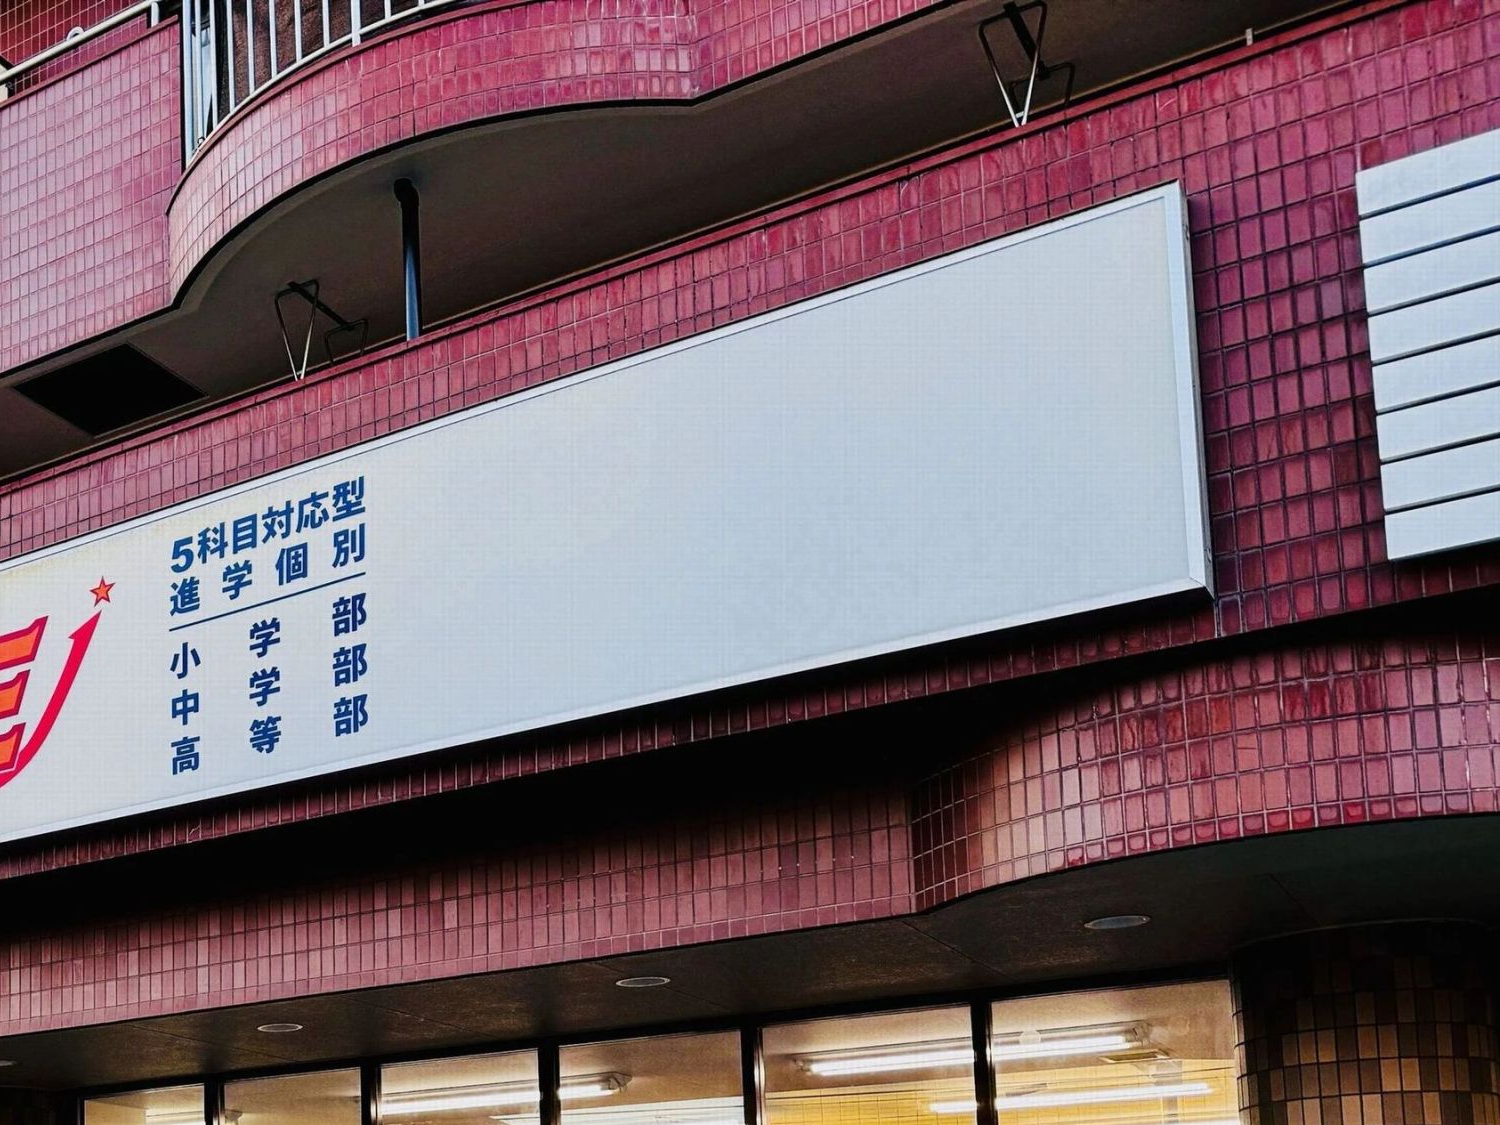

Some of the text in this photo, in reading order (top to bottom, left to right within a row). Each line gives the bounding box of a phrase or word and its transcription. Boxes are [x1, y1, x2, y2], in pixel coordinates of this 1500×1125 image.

[171, 476, 366, 573] 5科目対応型
[170, 523, 366, 616] 進学個別
[170, 593, 367, 679] 小学部
[171, 643, 368, 726] 中学部
[171, 694, 368, 775] 高等部
